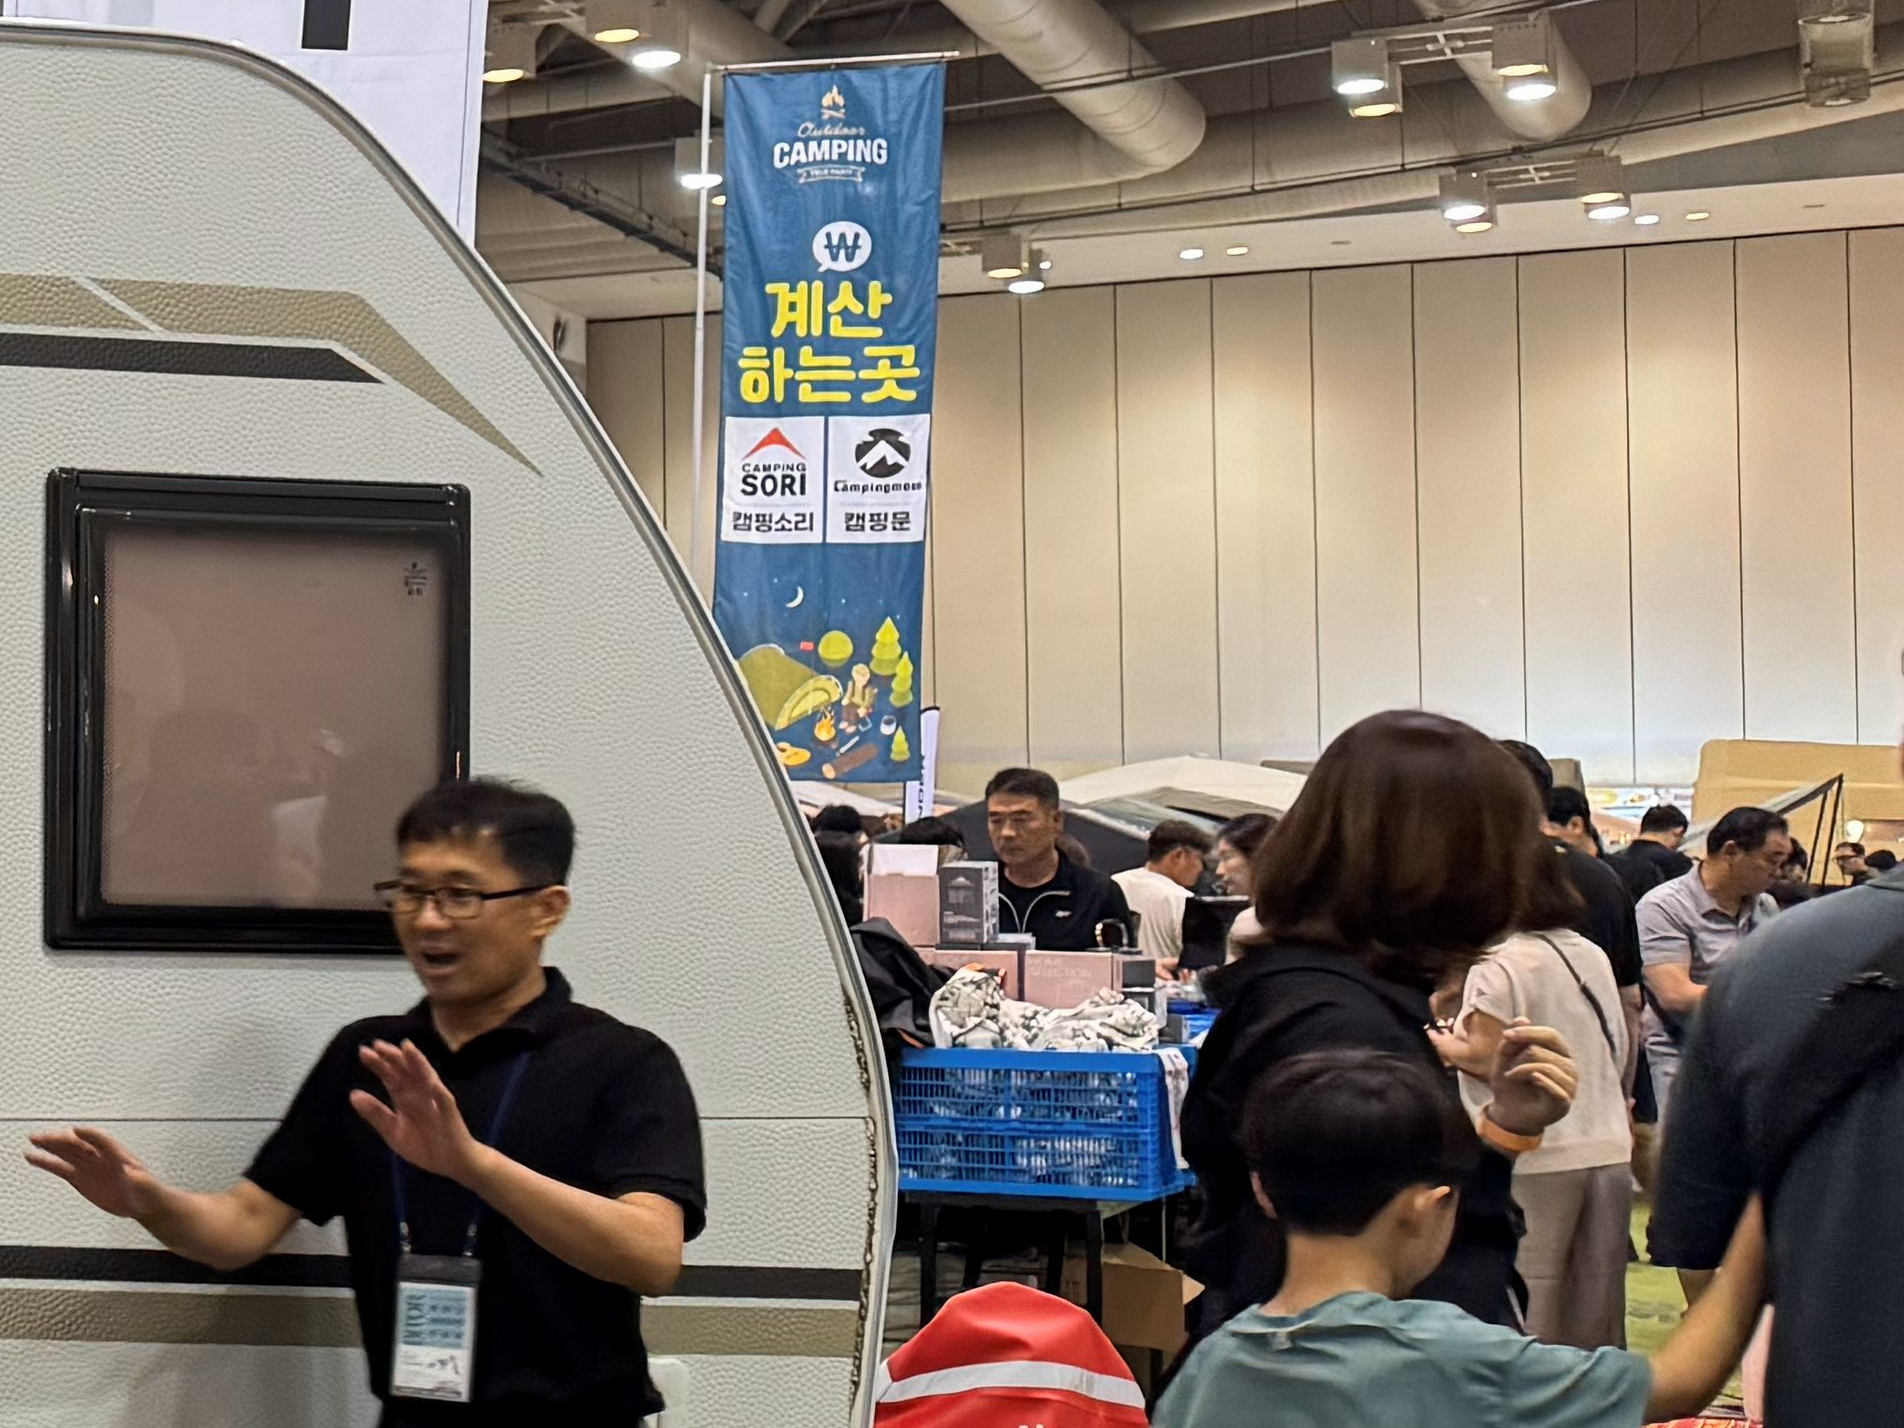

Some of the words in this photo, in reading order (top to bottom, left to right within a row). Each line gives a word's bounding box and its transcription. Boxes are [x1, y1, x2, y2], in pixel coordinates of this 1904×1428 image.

[773, 138, 888, 169] CAMPING
[764, 280, 893, 338] 계산
[738, 344, 921, 404] 하는곳
[742, 462, 807, 473] CAMPING
[741, 473, 807, 497] SORI
[733, 511, 814, 533] 캠핑소리
[845, 510, 911, 533] 캠핑문
